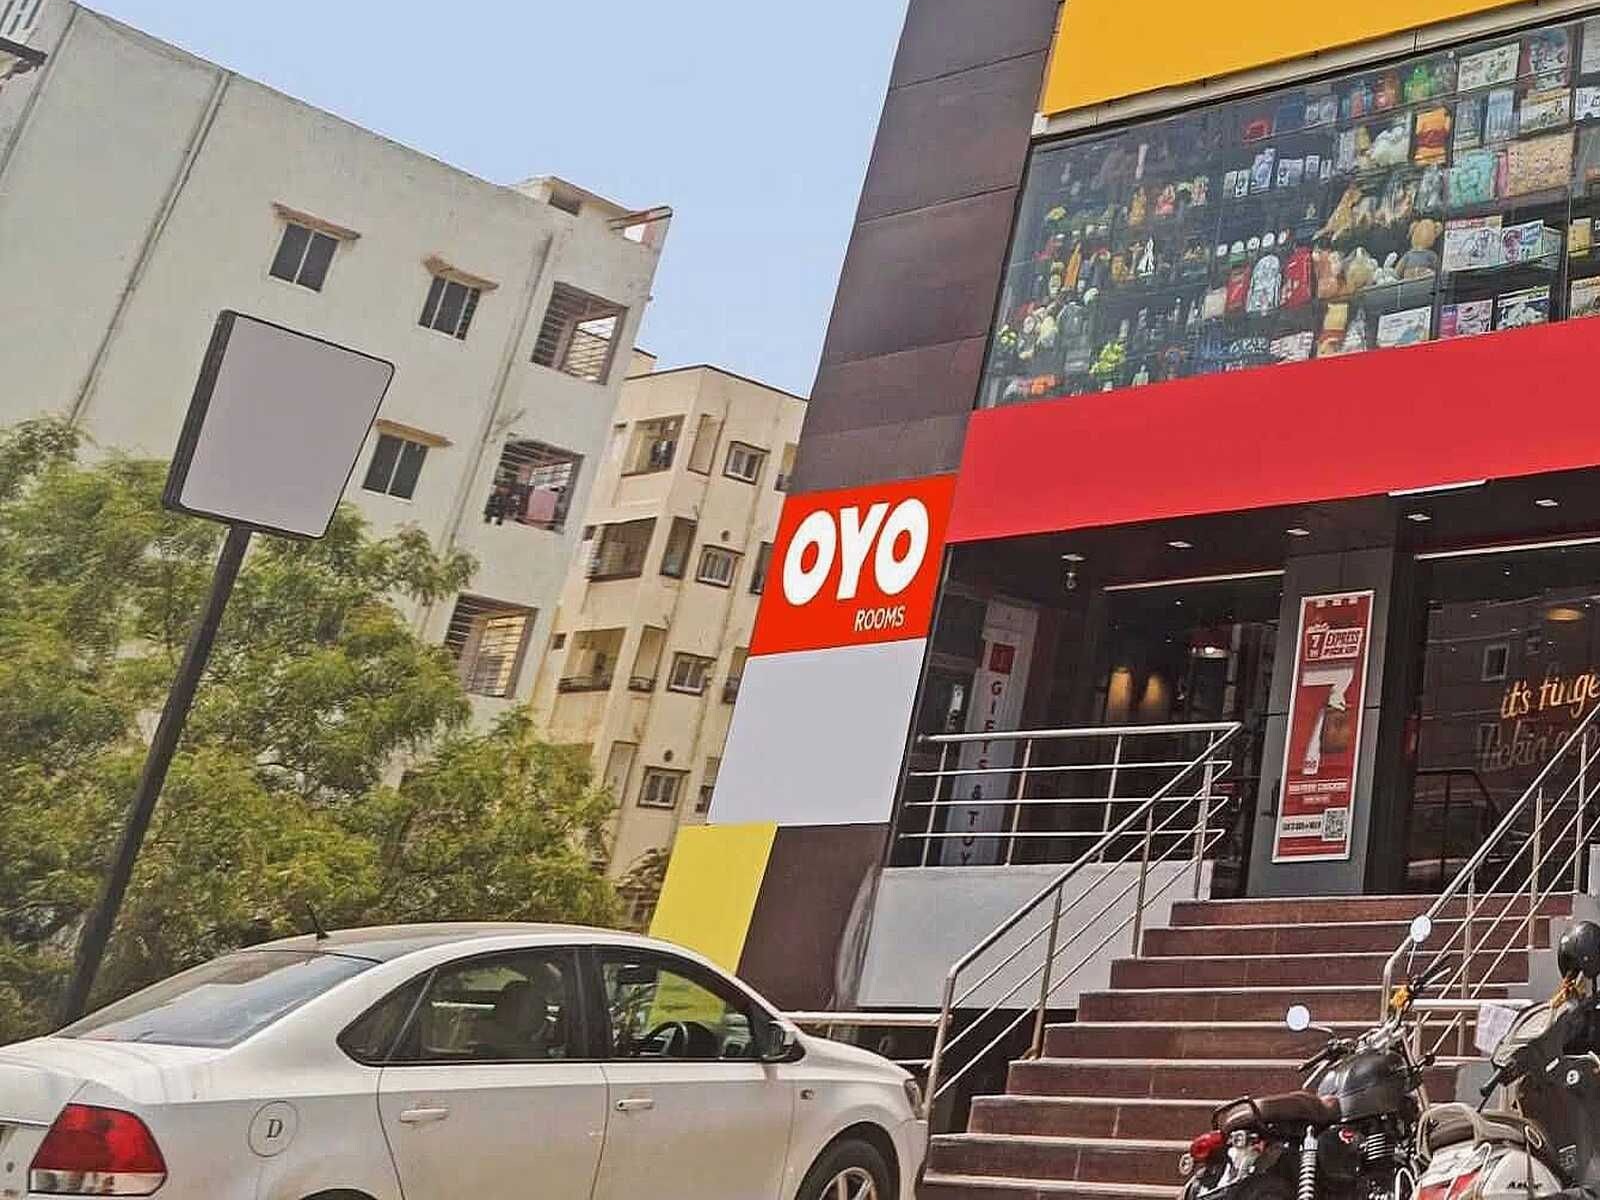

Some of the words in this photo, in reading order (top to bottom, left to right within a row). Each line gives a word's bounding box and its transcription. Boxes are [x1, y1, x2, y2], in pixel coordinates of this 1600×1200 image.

[783, 497, 929, 606] OYO
[854, 606, 906, 631] ROOMS
[1500, 679, 1532, 719] it's
[267, 1118, 283, 1138] D
